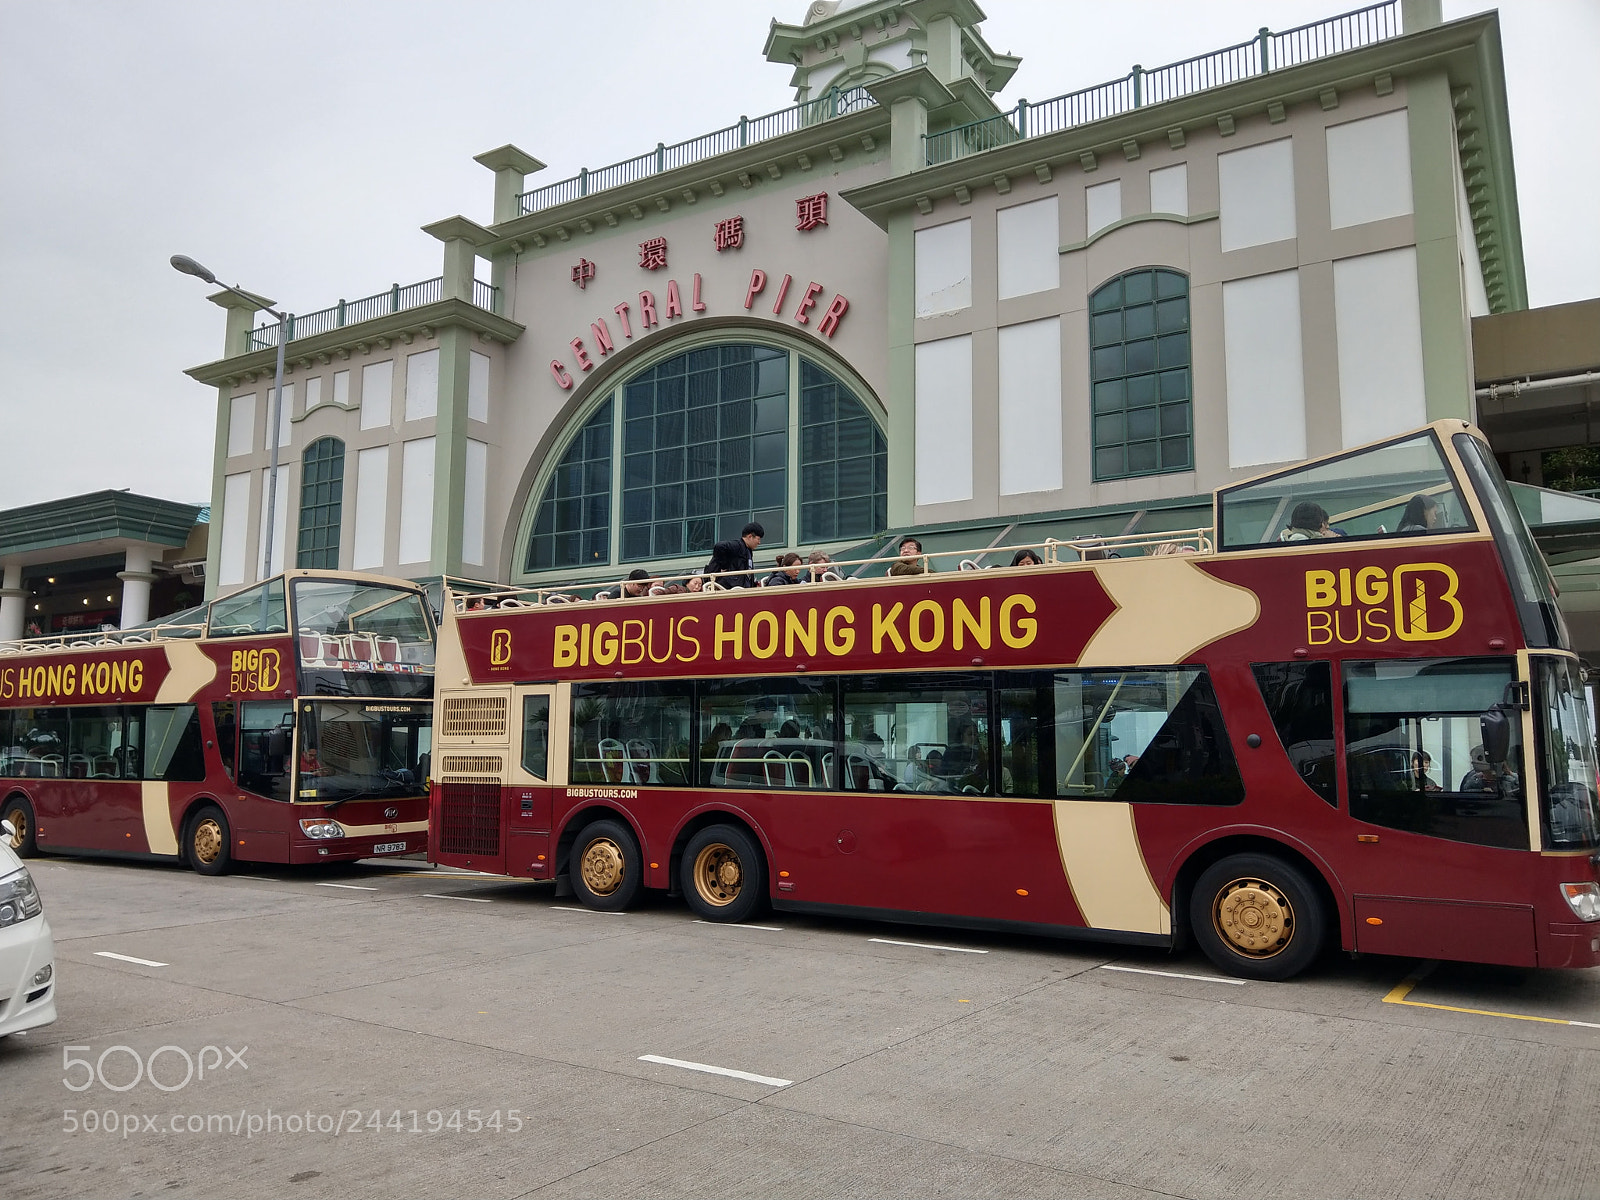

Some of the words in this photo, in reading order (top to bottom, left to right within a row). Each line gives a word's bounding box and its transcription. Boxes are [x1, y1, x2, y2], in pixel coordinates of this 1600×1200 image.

[570, 191, 829, 289] 中環碼頭
[550, 273, 706, 390] CENTRAL
[744, 269, 849, 338] PIER
[1305, 566, 1389, 608] BIG
[714, 605, 855, 660] HONG
[872, 593, 1038, 654] KONG
[1307, 608, 1391, 645] BUS
[18, 664, 76, 698] HONG
[81, 659, 144, 695] KONG
[231, 649, 259, 672] BIG
[230, 672, 258, 692] BUS
[566, 788, 638, 799] BIGBUSTOURS.COM
[375, 844, 386, 852] NR
